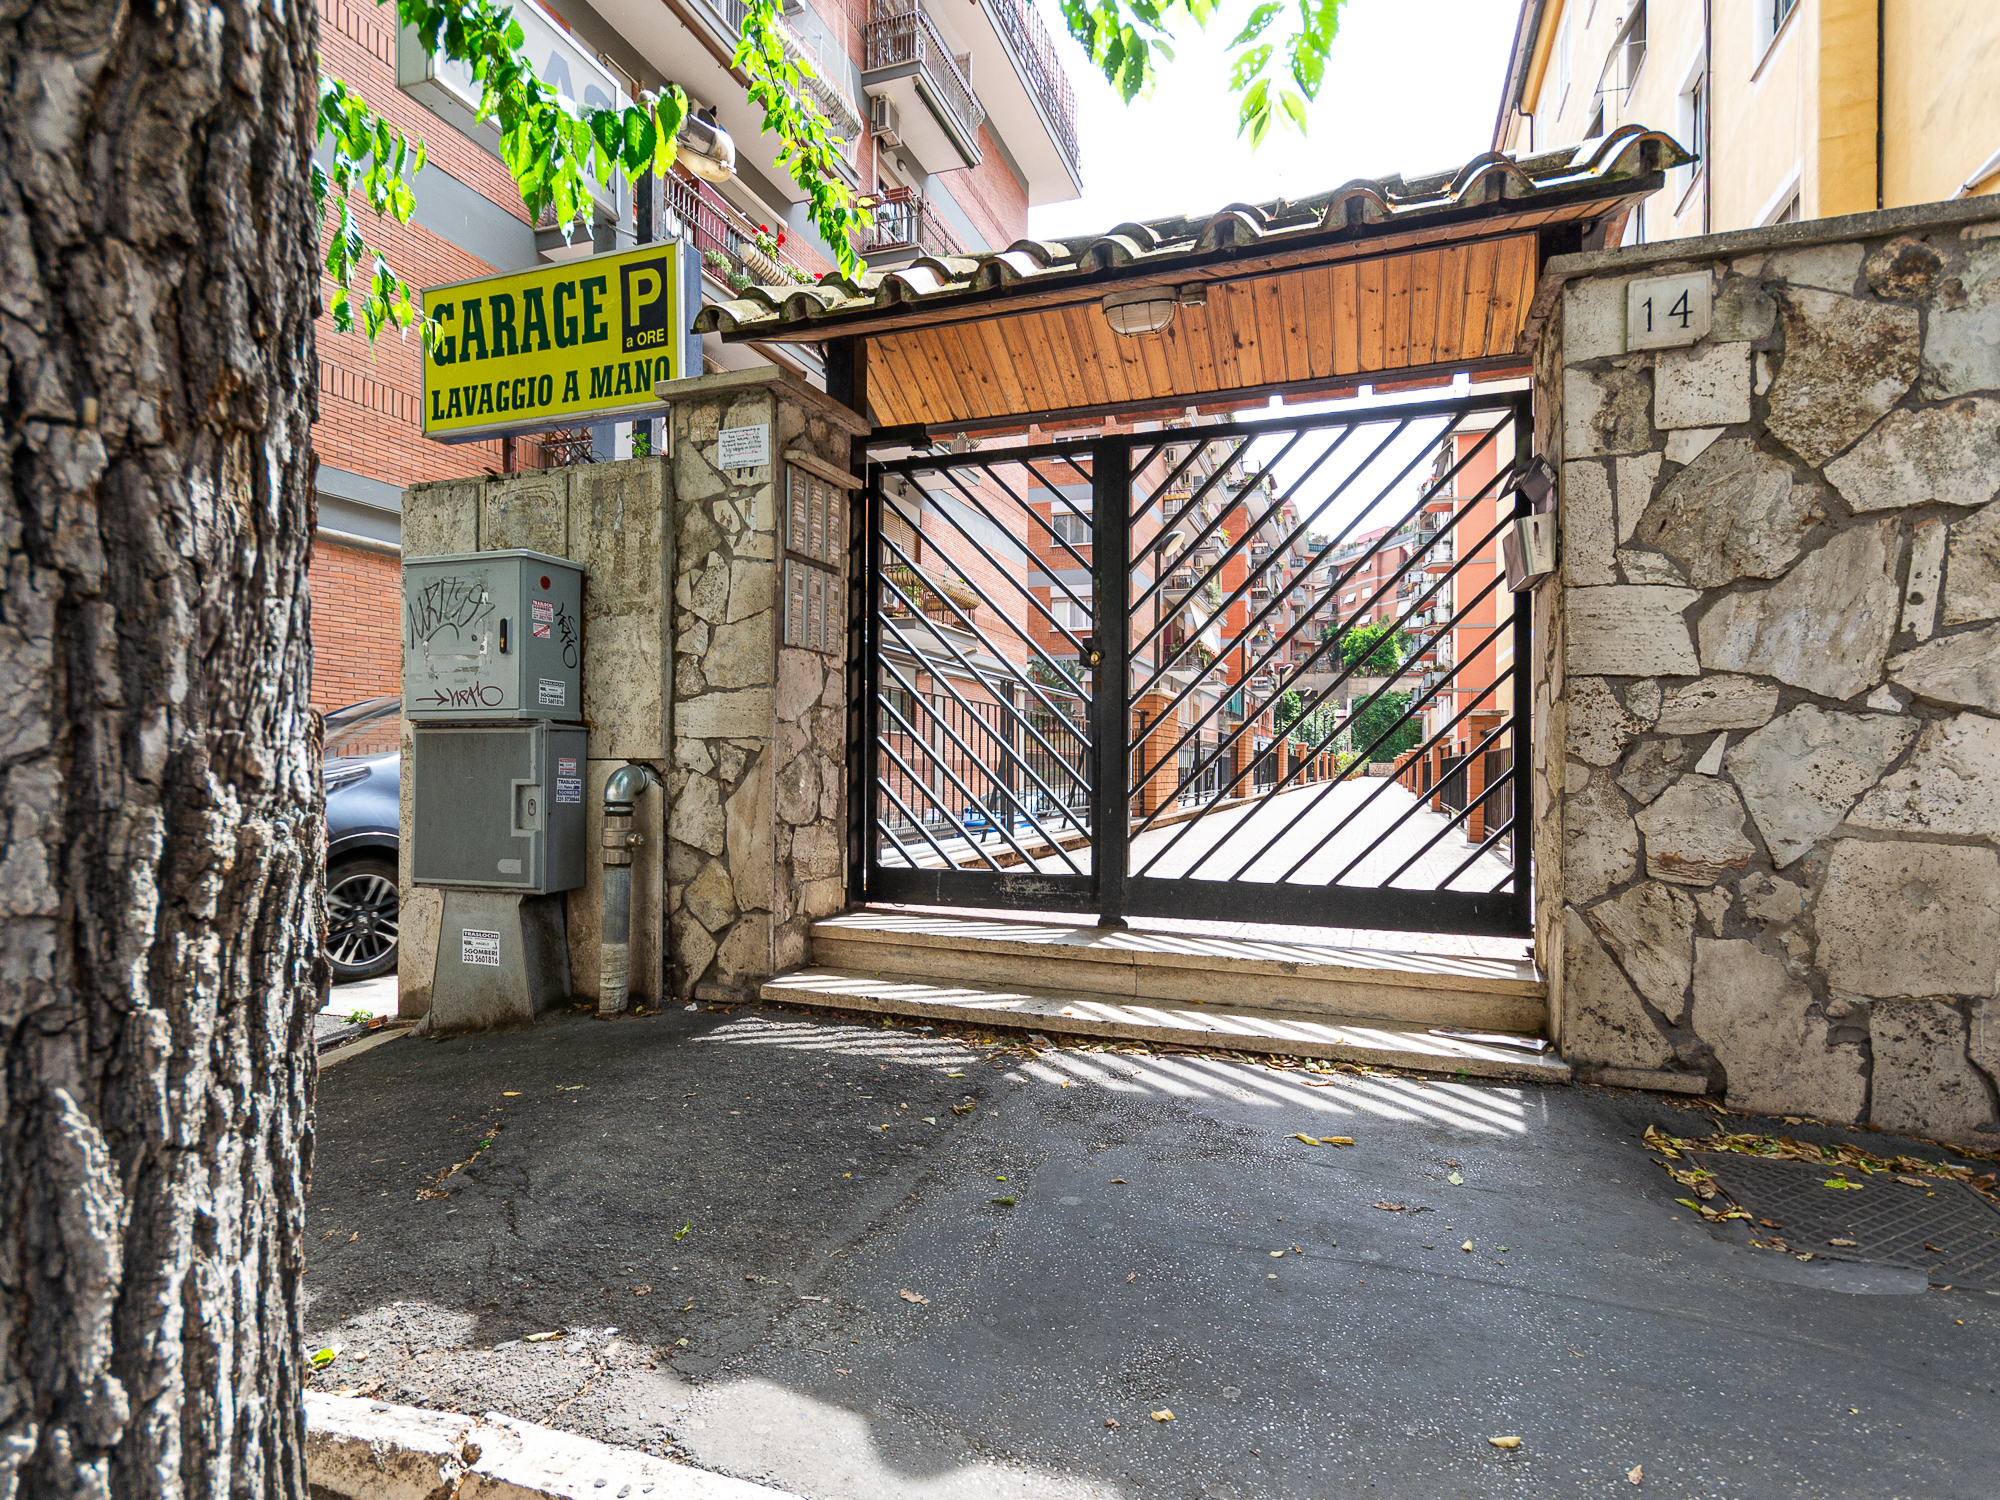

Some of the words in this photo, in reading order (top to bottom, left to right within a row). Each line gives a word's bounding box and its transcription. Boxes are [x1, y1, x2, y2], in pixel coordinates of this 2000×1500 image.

[628, 267, 662, 327] P
[1641, 289, 1693, 332] 14
[432, 275, 608, 367] GARAGE
[626, 335, 634, 348] a
[637, 328, 665, 346] ORE
[432, 374, 553, 421] LAVAGGIO
[562, 370, 580, 404] A
[589, 355, 670, 400] MANO
[464, 931, 498, 939] TRASLOCHI
[464, 948, 497, 956] SGOMBERI
